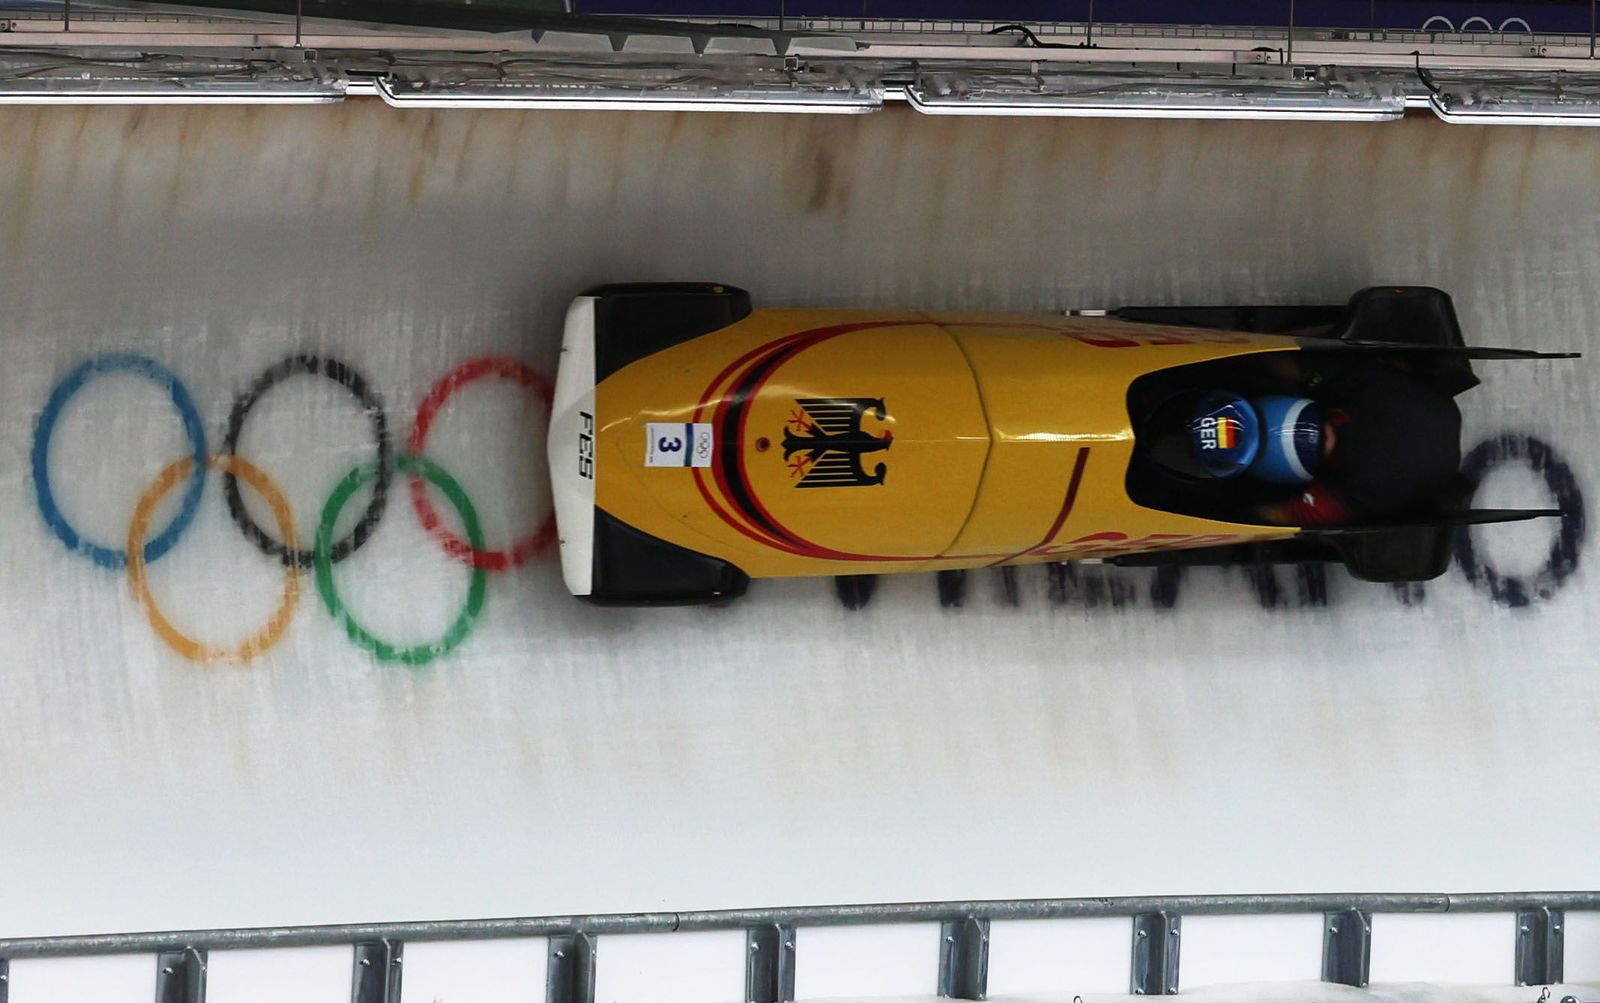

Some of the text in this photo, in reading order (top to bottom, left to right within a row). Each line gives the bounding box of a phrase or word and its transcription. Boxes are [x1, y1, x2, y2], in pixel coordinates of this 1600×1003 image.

[579, 411, 593, 480] FES
[658, 436, 682, 453] 3
[1200, 417, 1217, 450] GER
